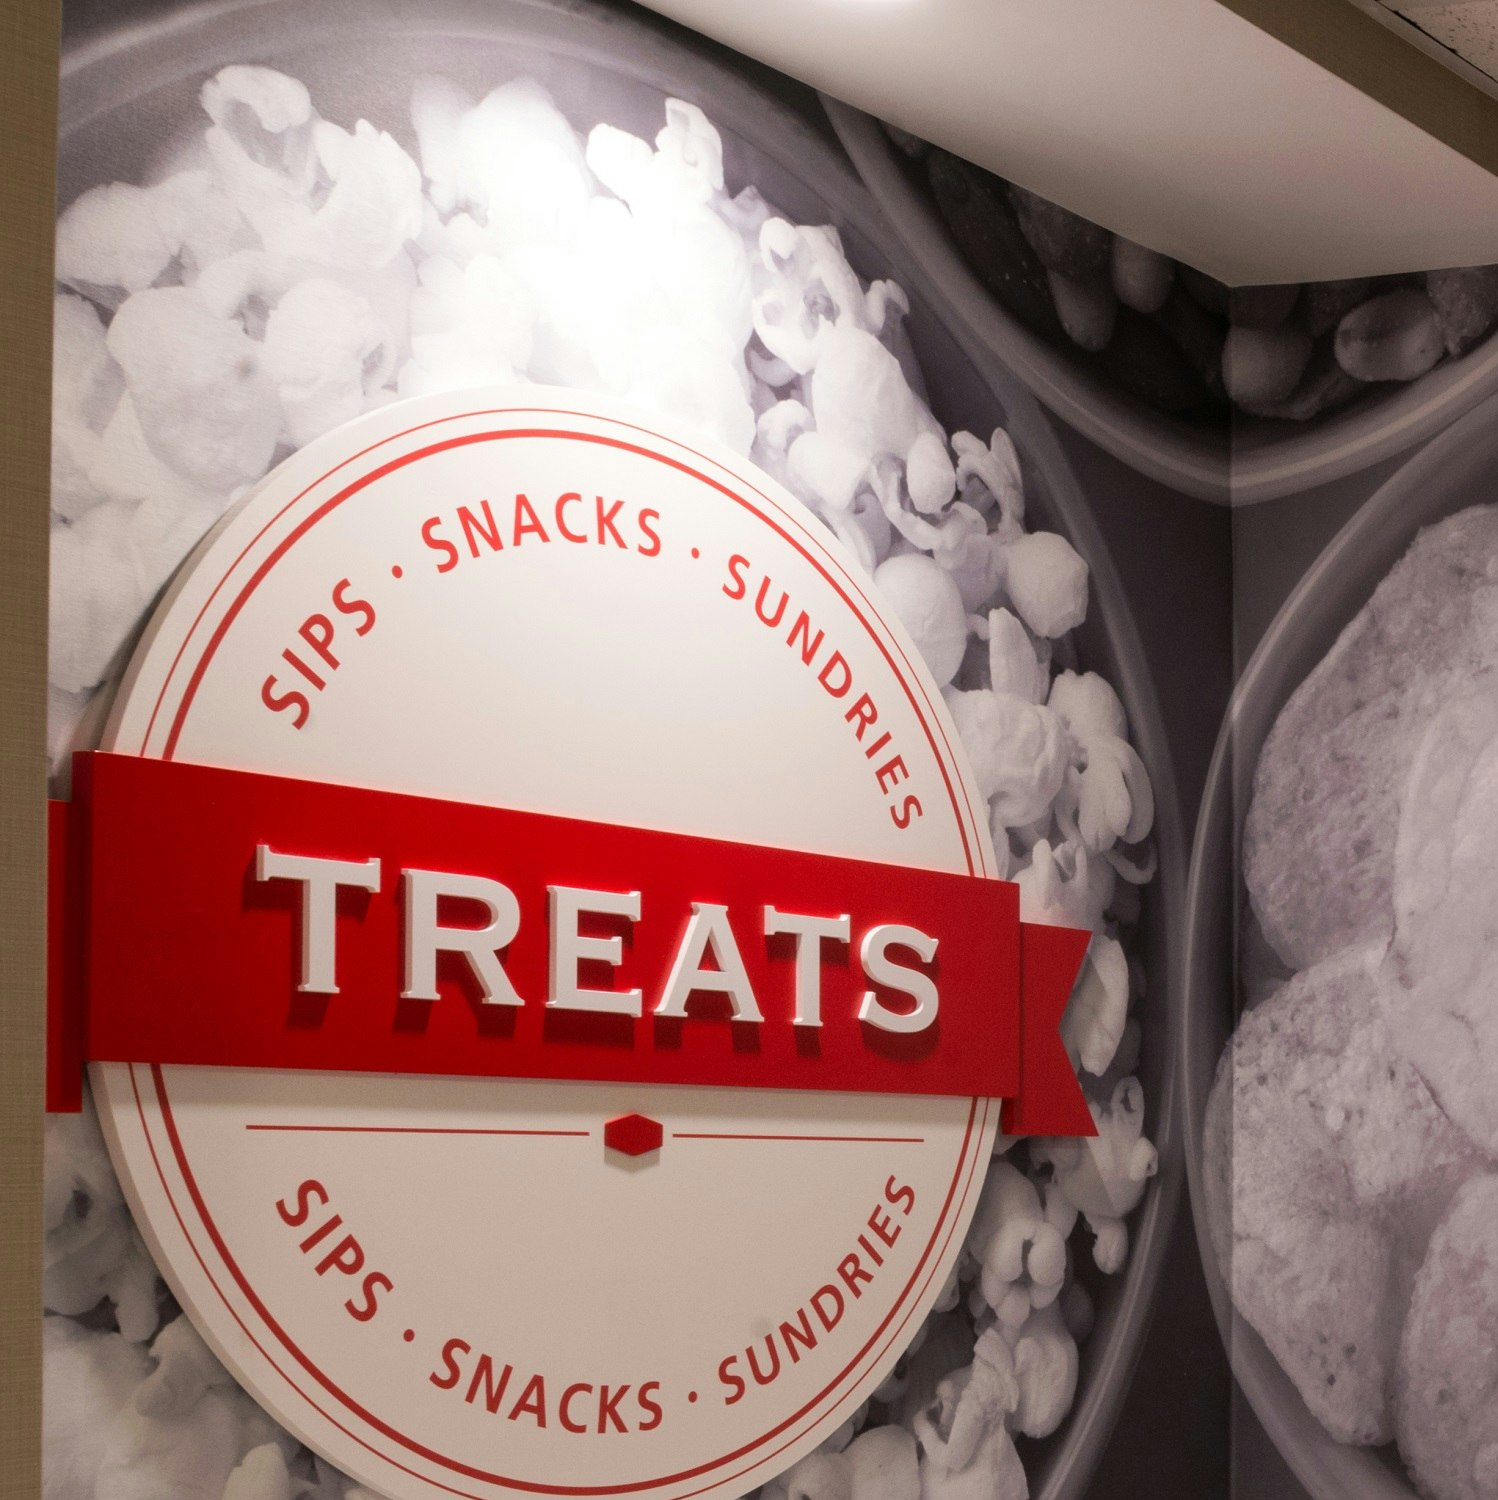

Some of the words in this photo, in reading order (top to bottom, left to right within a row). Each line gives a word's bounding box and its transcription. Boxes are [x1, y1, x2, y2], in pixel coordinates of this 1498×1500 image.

[260, 578, 379, 730] SIPS
[421, 493, 664, 575] SNACKS
[722, 553, 924, 830] SUNDRIES
[256, 843, 940, 1035] TREATS
[275, 1179, 395, 1324] SIPS
[430, 1335, 665, 1434] SNACKS
[719, 1175, 917, 1407] SUNDRIES
